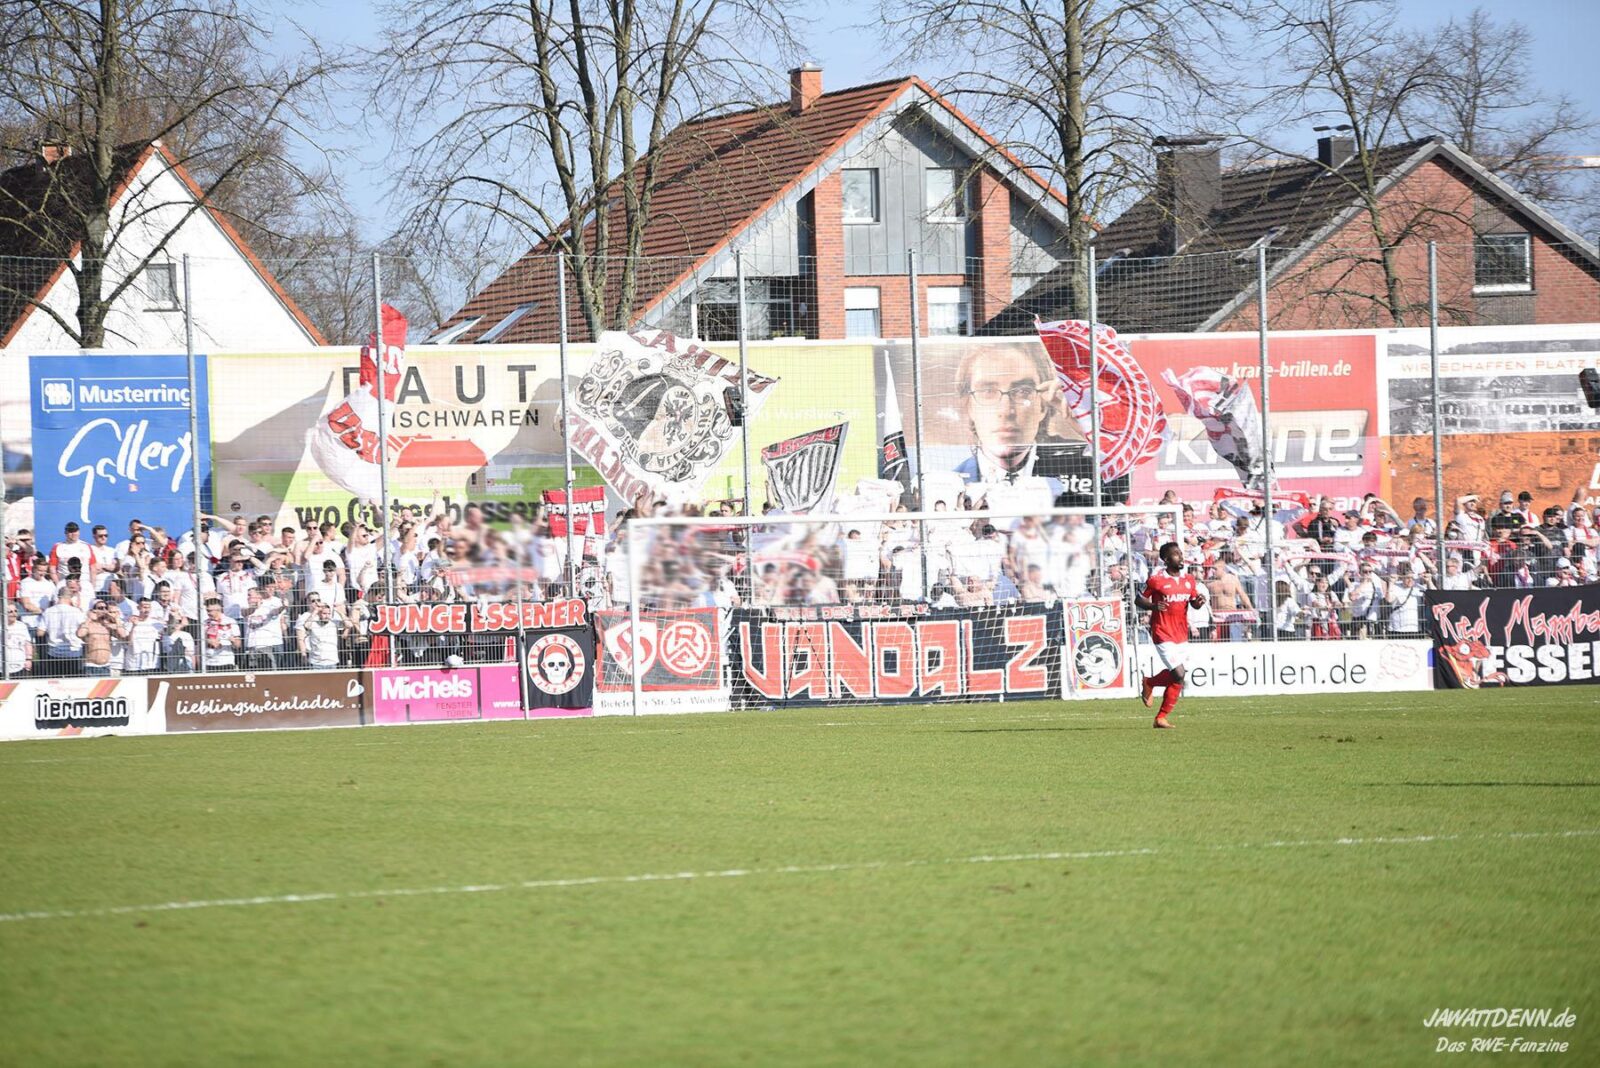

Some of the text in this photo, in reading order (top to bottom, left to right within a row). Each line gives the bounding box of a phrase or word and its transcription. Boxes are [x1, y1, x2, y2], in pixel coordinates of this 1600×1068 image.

[1401, 363, 1430, 372] WIR
[1440, 361, 1526, 372] SCHAFFEN
[1536, 359, 1586, 369] PLATZ
[79, 384, 192, 407] Musterring
[392, 409, 539, 428] ISCHWAREN
[58, 417, 193, 524] Gallery
[1060, 474, 1092, 493] äte
[295, 505, 341, 530] wo
[368, 598, 586, 633] JUNGE ESSENER
[1069, 602, 1122, 632] LPL
[1432, 597, 1492, 645] Red
[382, 675, 473, 700] Michels
